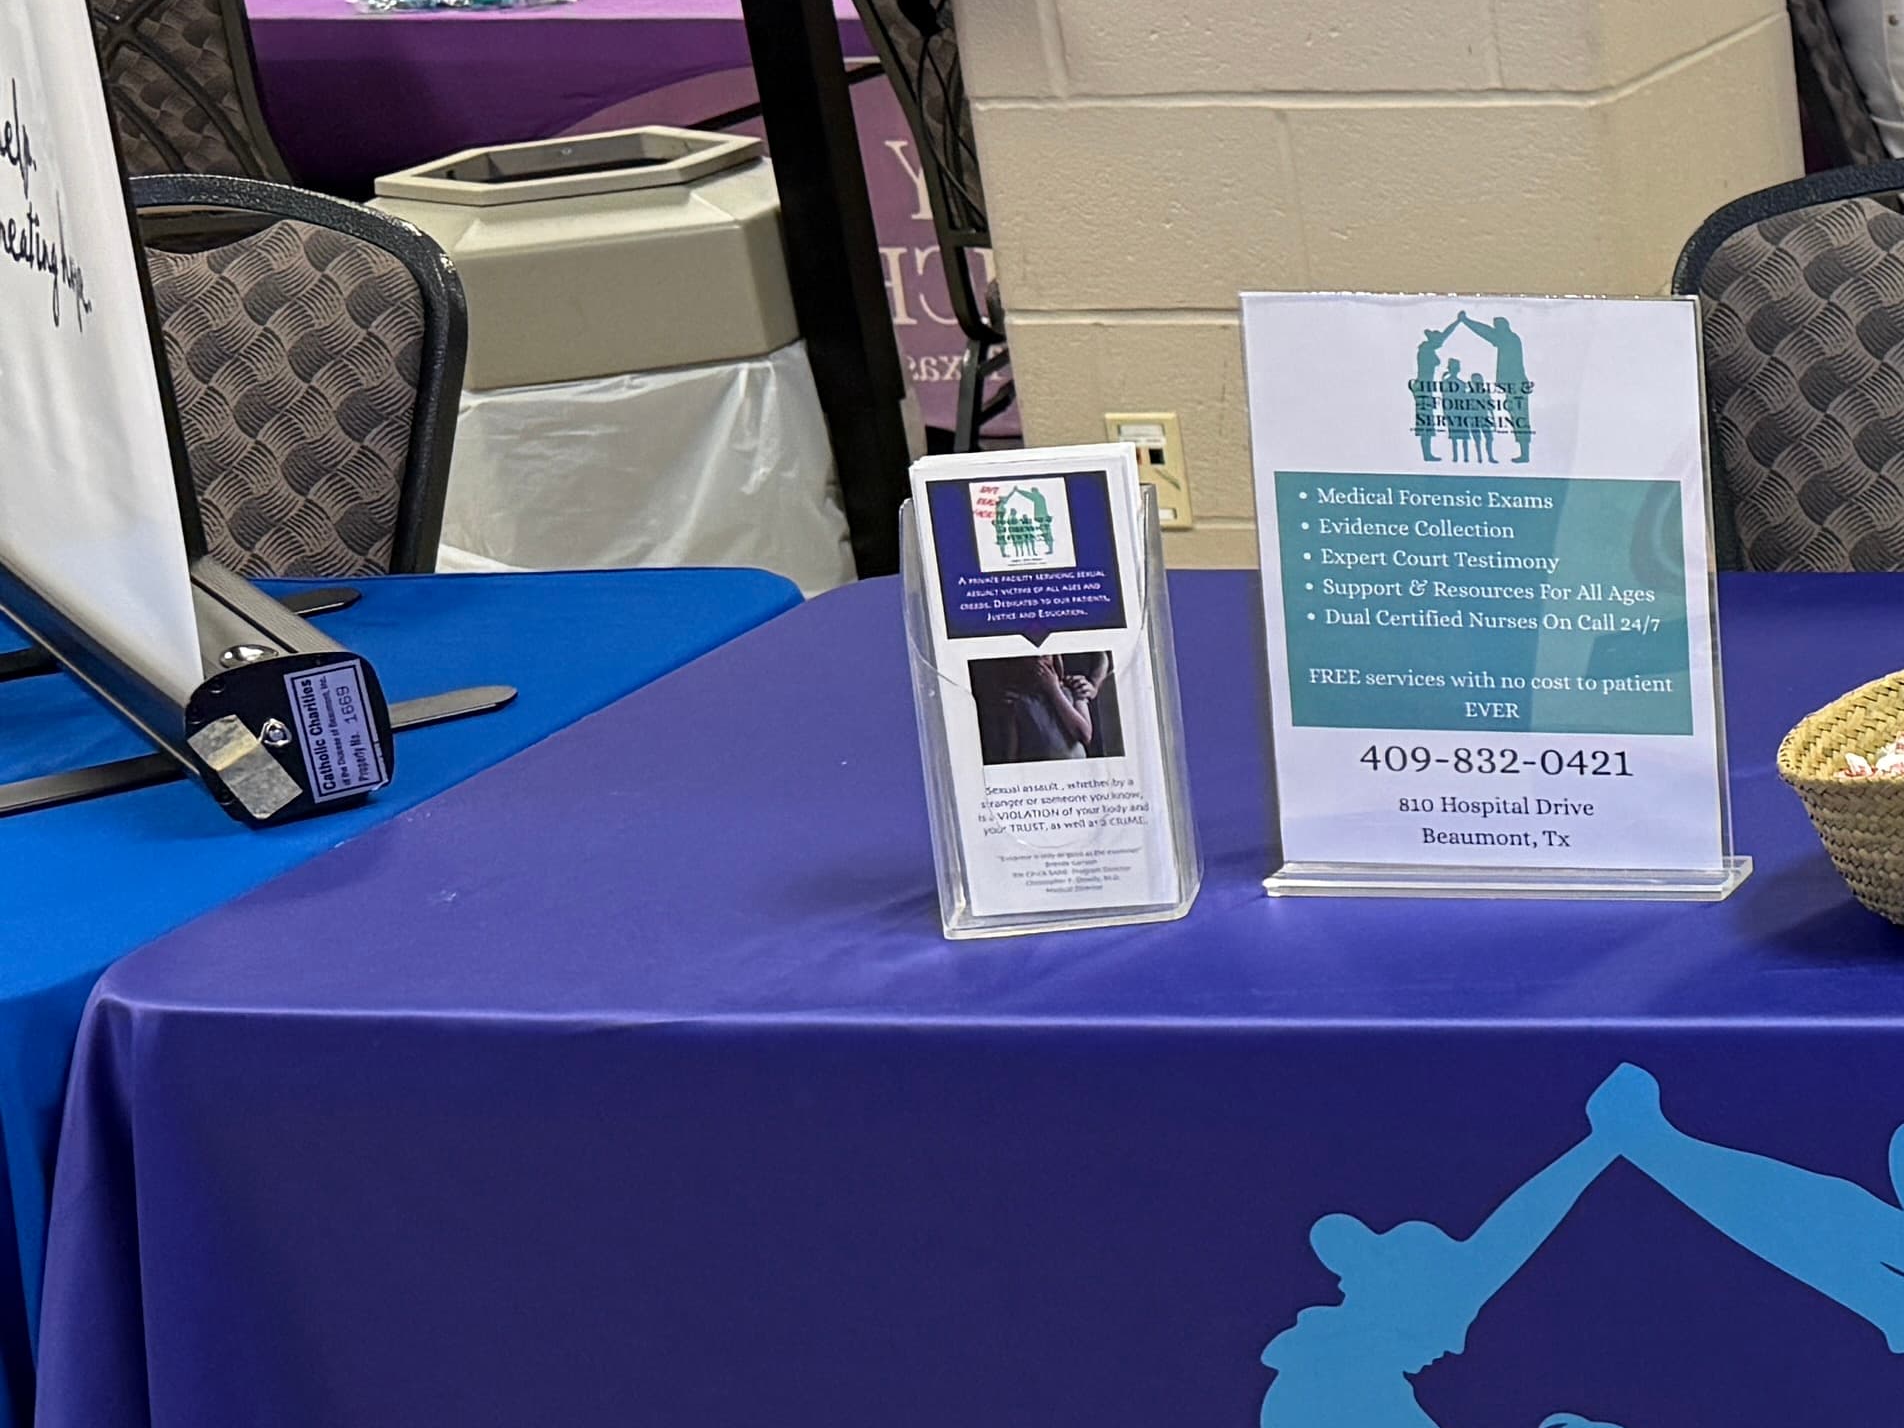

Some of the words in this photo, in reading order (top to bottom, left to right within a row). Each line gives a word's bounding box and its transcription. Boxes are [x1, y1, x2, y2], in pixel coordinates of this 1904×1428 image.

[1408, 379, 1460, 393] CHILD
[1520, 381, 1535, 394] &
[1317, 487, 1394, 506] Medical
[1399, 489, 1483, 509] Forensic
[1487, 491, 1554, 510] Exams
[1319, 518, 1409, 538] Evidence
[1414, 519, 1515, 540] Collection
[1320, 548, 1388, 570] Expert
[1393, 550, 1449, 570] Court
[1454, 551, 1559, 574] Testimony
[958, 576, 967, 586] A
[1076, 570, 1106, 579] SEXUAL
[1083, 582, 1101, 591] AND
[994, 598, 1038, 609] DEDICATED
[1323, 578, 1402, 600] Support
[1408, 578, 1429, 597] &
[1433, 581, 1534, 601] Resources
[1539, 583, 1571, 601] For
[1576, 583, 1603, 602] All
[1608, 585, 1655, 607] Ages
[1019, 611, 1036, 619] AND
[1325, 608, 1371, 627] Dual
[1376, 608, 1464, 629] Certified
[1469, 612, 1538, 630] Nurses
[1543, 613, 1572, 631] On
[1577, 613, 1616, 632] Call
[1620, 615, 1661, 634] 24/7
[1309, 667, 1361, 686] FREE
[1365, 670, 1446, 689] services
[1451, 670, 1496, 690] with
[1501, 676, 1526, 691] no
[1531, 674, 1571, 692] cost
[1576, 674, 1598, 692] to
[1602, 675, 1673, 696] patient
[301, 678, 323, 736] Charities
[1464, 701, 1520, 720] EVER
[313, 738, 336, 791] Catholic
[1359, 744, 1634, 778] 409-832-0421
[985, 784, 1021, 796] Sexual
[1112, 778, 1124, 788] by
[1041, 796, 1088, 805] someone
[1090, 794, 1109, 804] you
[1398, 797, 1434, 815] 810
[1440, 796, 1531, 819] Hospital
[1536, 797, 1595, 818] Drive
[997, 809, 1059, 821] VIOLATION
[1062, 807, 1073, 817] of
[1076, 806, 1099, 817] your
[1101, 805, 1126, 815] body
[1129, 802, 1149, 812] and
[1010, 822, 1049, 833] TRUST,
[1050, 822, 1061, 830] as
[1064, 819, 1085, 829] well
[1422, 828, 1538, 850] Beaumont,
[1542, 830, 1571, 849] Tx
